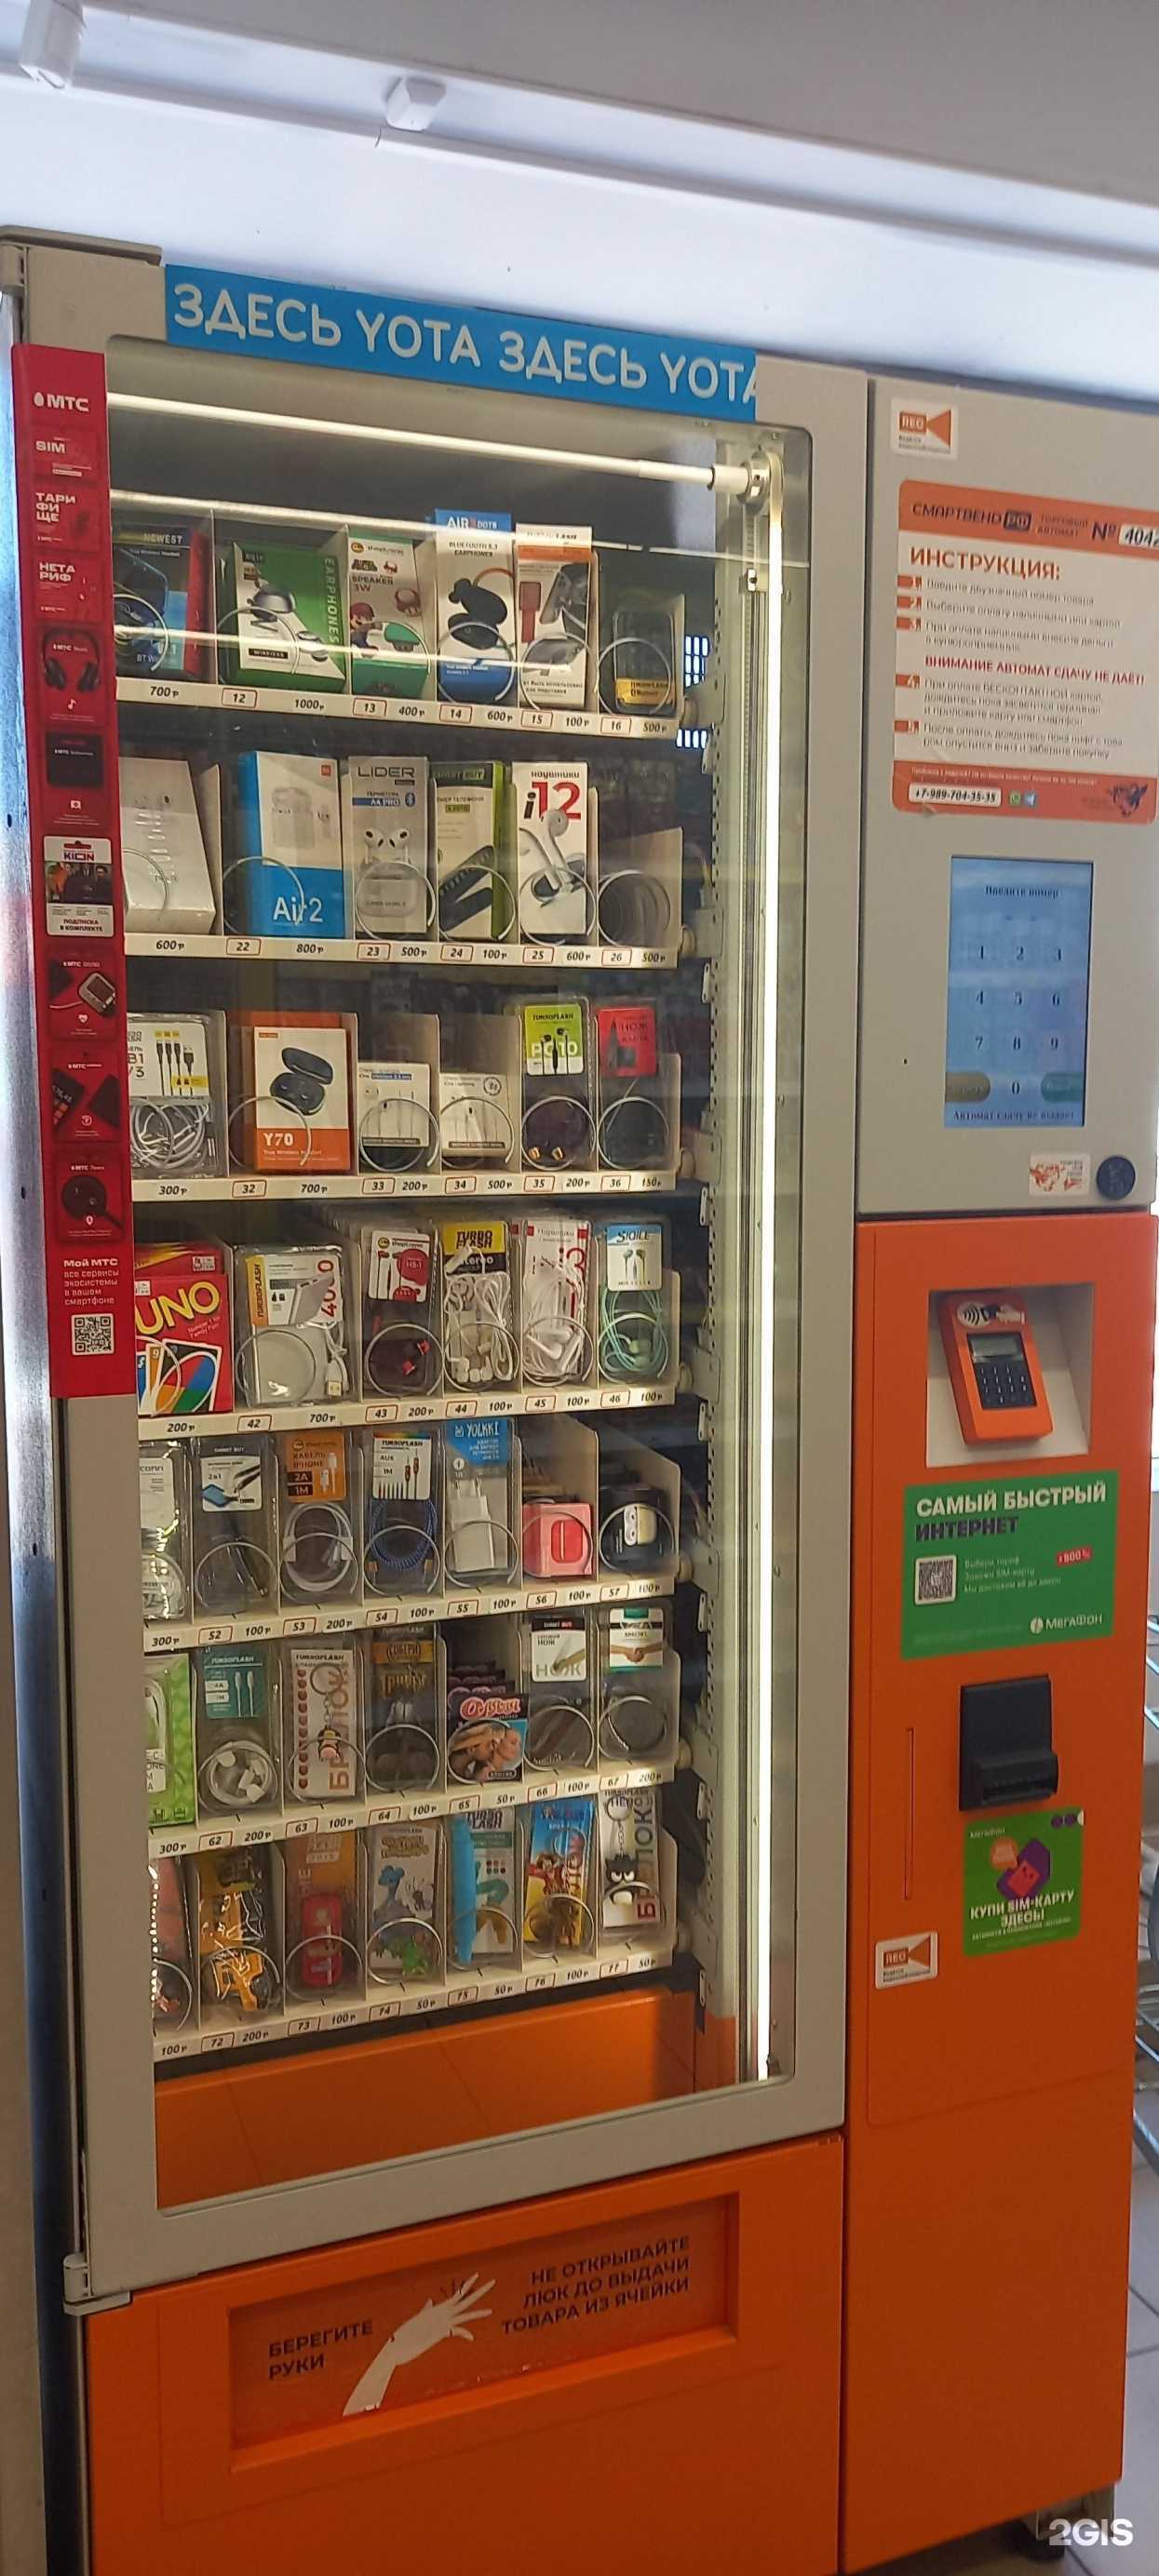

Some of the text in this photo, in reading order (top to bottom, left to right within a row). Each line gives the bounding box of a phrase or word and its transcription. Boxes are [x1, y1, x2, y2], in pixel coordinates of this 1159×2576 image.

[174, 284, 343, 347] ЗДЕСЬ
[356, 309, 481, 368] YOTA
[498, 330, 648, 391] ЗДЕСЬ
[47, 394, 89, 412] МТС
[35, 440, 66, 454] SIM
[35, 492, 76, 503] ТАРИ
[35, 502, 60, 513] ФИ
[36, 512, 60, 523] ЩЕ
[39, 562, 75, 573] НЕТА
[910, 546, 1060, 581] ИНСТРУКЦИЯ:
[39, 571, 72, 583] РИФ
[324, 557, 342, 645] EARPHONES
[924, 655, 993, 672] ВНИМАНИЕ
[996, 662, 1052, 678] АВТОМАТ
[1054, 666, 1091, 681] СДАЧУ
[1095, 670, 1110, 682] НЕ
[233, 693, 246, 704] 12
[364, 703, 375, 713] 13
[450, 709, 462, 719] 14
[532, 715, 544, 725] 15
[611, 720, 622, 731] 16
[357, 766, 416, 779] LIDER
[236, 942, 249, 951] 22
[367, 946, 380, 957] 23
[451, 948, 463, 958] 24
[532, 950, 544, 959] 25
[263, 1132, 294, 1147] Y70
[372, 1181, 384, 1191] 33
[453, 1180, 466, 1189] 34
[532, 1178, 545, 1188] 35
[610, 1178, 622, 1188] 36
[242, 1184, 256, 1194] 32
[63, 1258, 118, 1268] Мой МТС
[81, 1269, 119, 1279] сервисы
[64, 1297, 115, 1307] смартфоне
[135, 1281, 222, 1335] UNO
[534, 1399, 546, 1408] 45
[375, 1409, 387, 1418] 43
[455, 1404, 467, 1414] 44
[247, 1419, 261, 1429] 42
[916, 1480, 1107, 1517] САМЫЙ БЫСТРЫЙ
[915, 1516, 1019, 1542] ИНТЕРНЕТ
[535, 1596, 547, 1605] 56
[456, 1603, 468, 1614] 55
[375, 1612, 388, 1622] 54
[292, 1621, 305, 1631] 53
[209, 1630, 222, 1641] 52
[536, 1788, 548, 1796] 66
[458, 1801, 470, 1810] 65
[378, 1811, 391, 1821] 64
[295, 1823, 308, 1833] 63
[209, 1836, 222, 1846] 62
[970, 1902, 1005, 1920] КУПИ
[379, 2006, 391, 2016] 74
[298, 2021, 310, 2031] 73
[210, 2038, 223, 2047] 72
[532, 2235, 691, 2286] НЕ ОТКРЫВАЙТЕ
[523, 2257, 690, 2310] ЛЮК ДО ВЫДАЧИ
[503, 2276, 690, 2336] ТОВАРА ИЗ ЯЧЕЙКИ
[268, 2321, 374, 2358] БЕРЕГИТЕ
[268, 2354, 325, 2381] РУКИ
